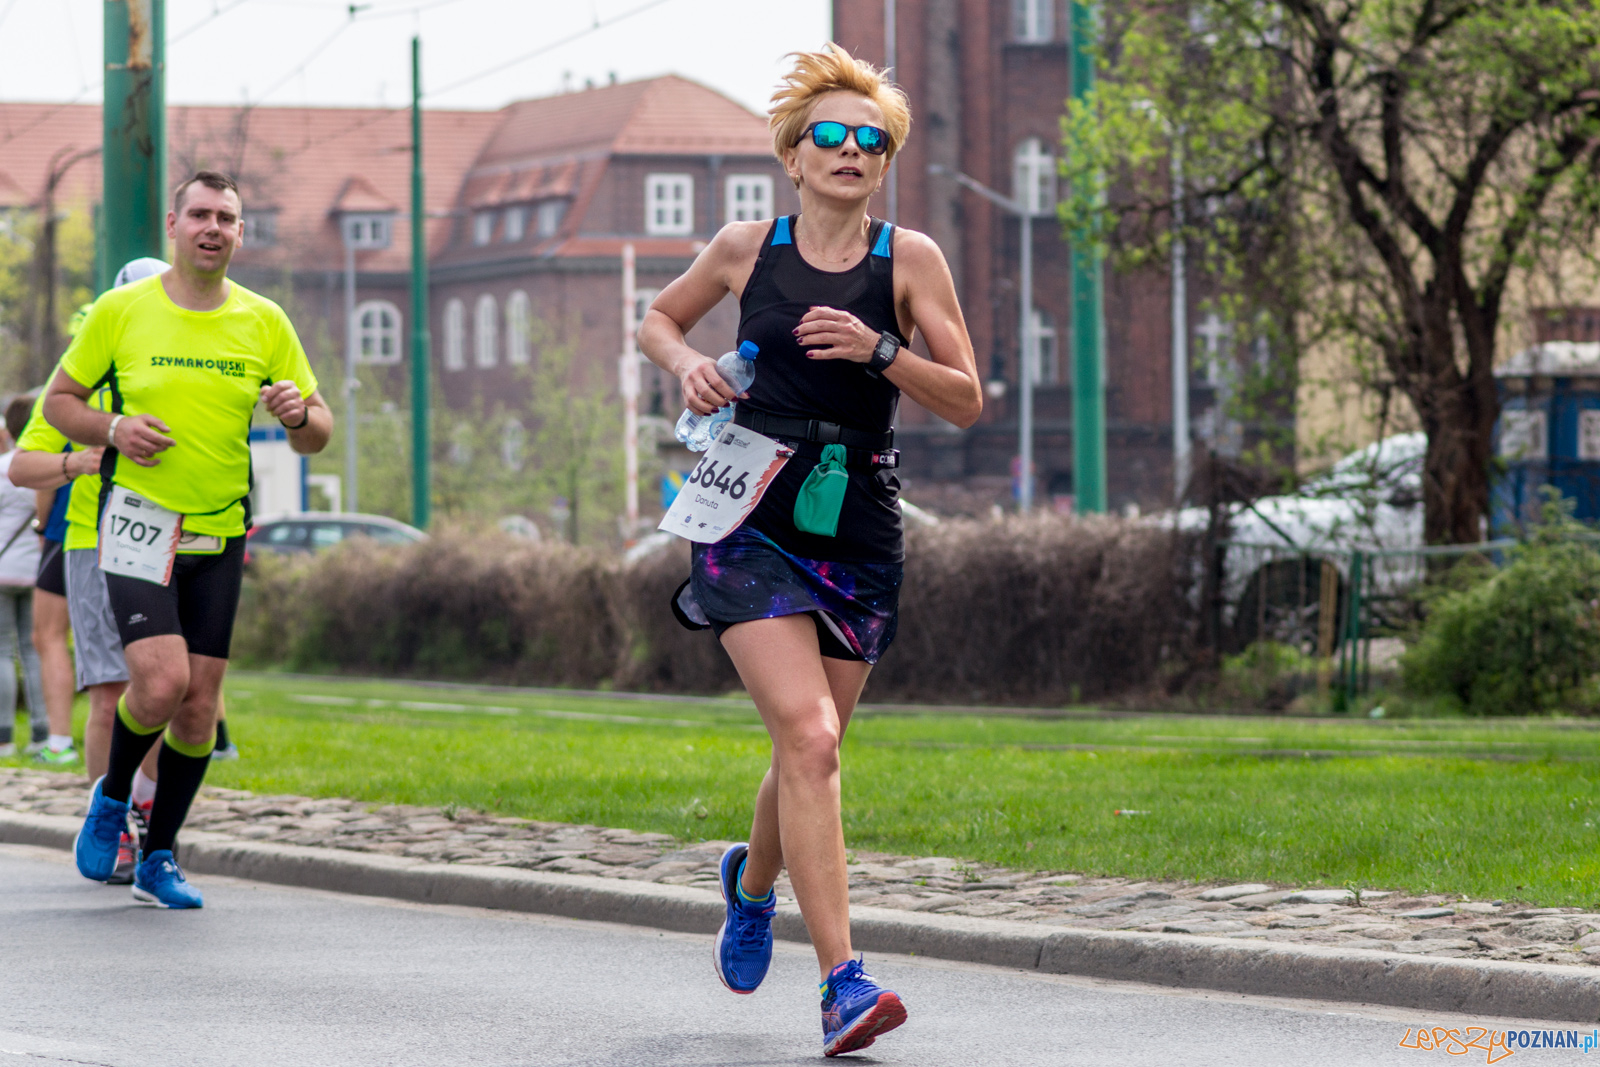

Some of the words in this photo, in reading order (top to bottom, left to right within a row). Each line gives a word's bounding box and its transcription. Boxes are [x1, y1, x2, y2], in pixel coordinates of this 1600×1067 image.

[151, 356, 245, 371] SZYMANOWSKI
[689, 457, 750, 500] 3646
[695, 494, 719, 509] Danuta
[111, 514, 162, 546] 1707
